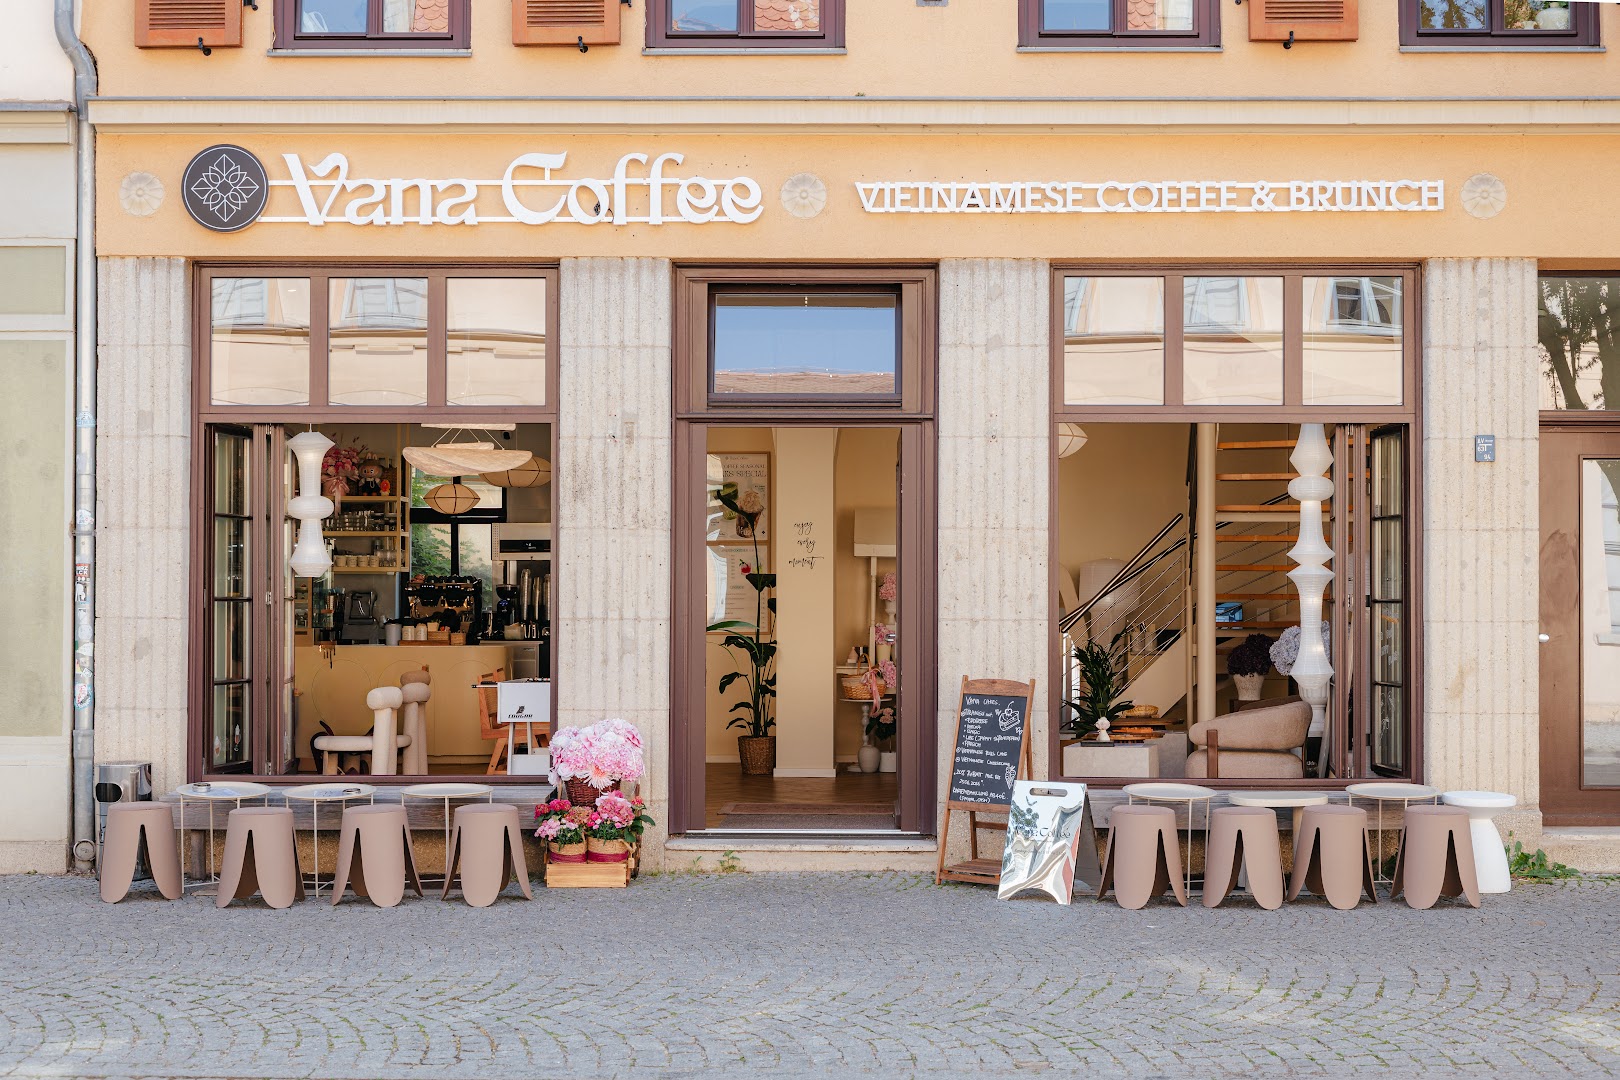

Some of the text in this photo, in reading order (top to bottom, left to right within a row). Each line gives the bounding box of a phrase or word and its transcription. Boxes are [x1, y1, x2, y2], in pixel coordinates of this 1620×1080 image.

[282, 150, 764, 227] Vana Coffee
[854, 178, 1445, 214] VIETNAMESE COFFEE & BRUNCH
[736, 470, 767, 478] SPECIAL
